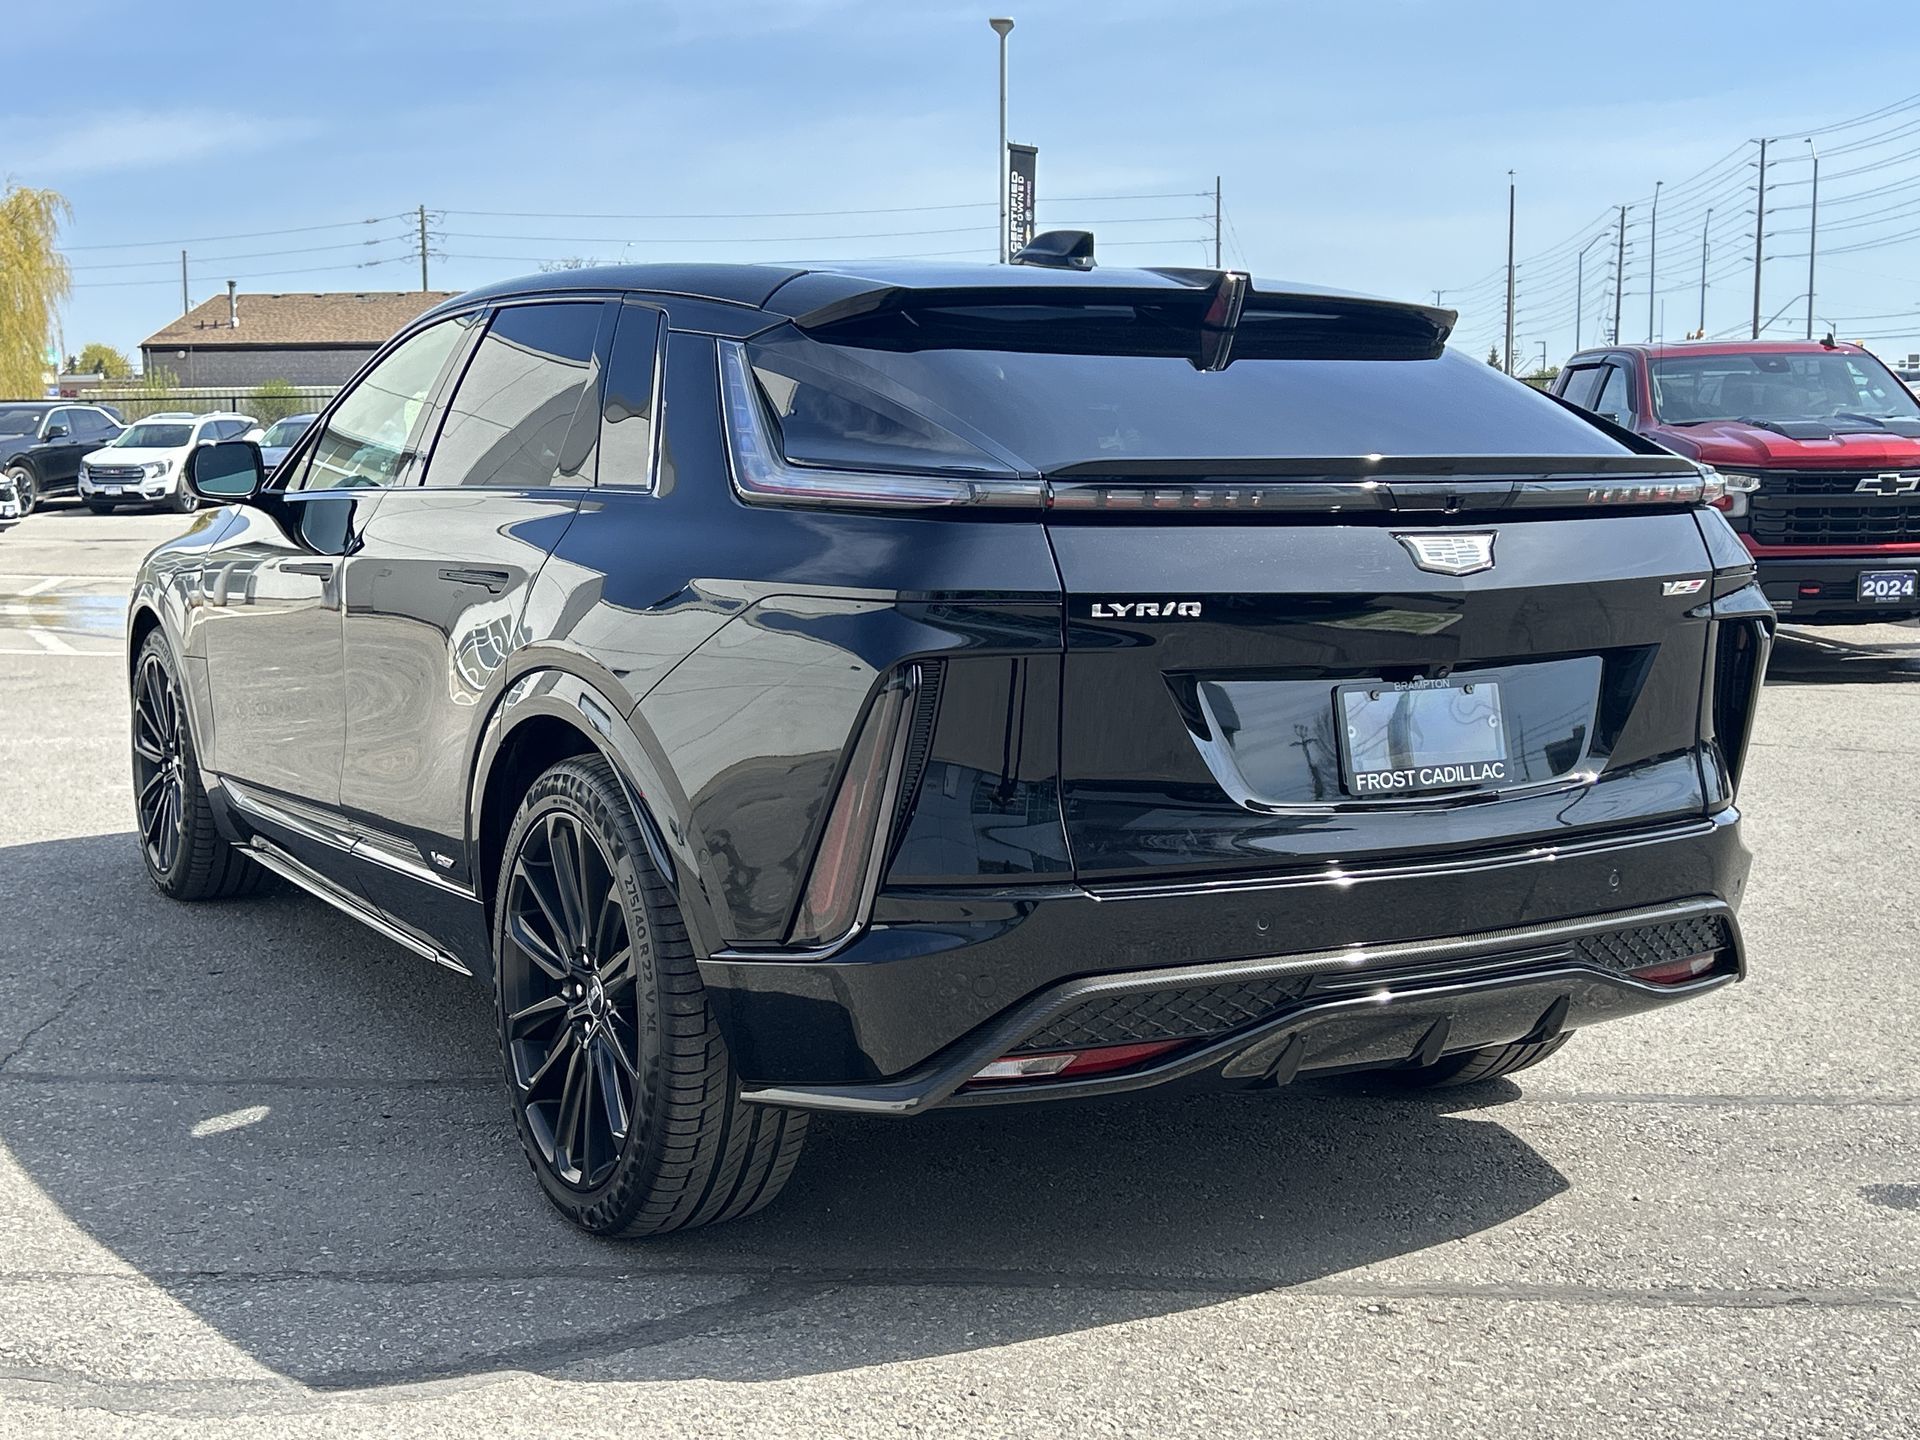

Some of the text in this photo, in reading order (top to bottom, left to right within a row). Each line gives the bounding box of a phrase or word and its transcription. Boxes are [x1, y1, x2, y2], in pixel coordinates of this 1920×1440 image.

[1862, 579, 1914, 597] 2024
[1393, 679, 1451, 691] BRAMPTON
[1355, 762, 1505, 791] FROST CADILLAC
[624, 874, 646, 941] 275/40
